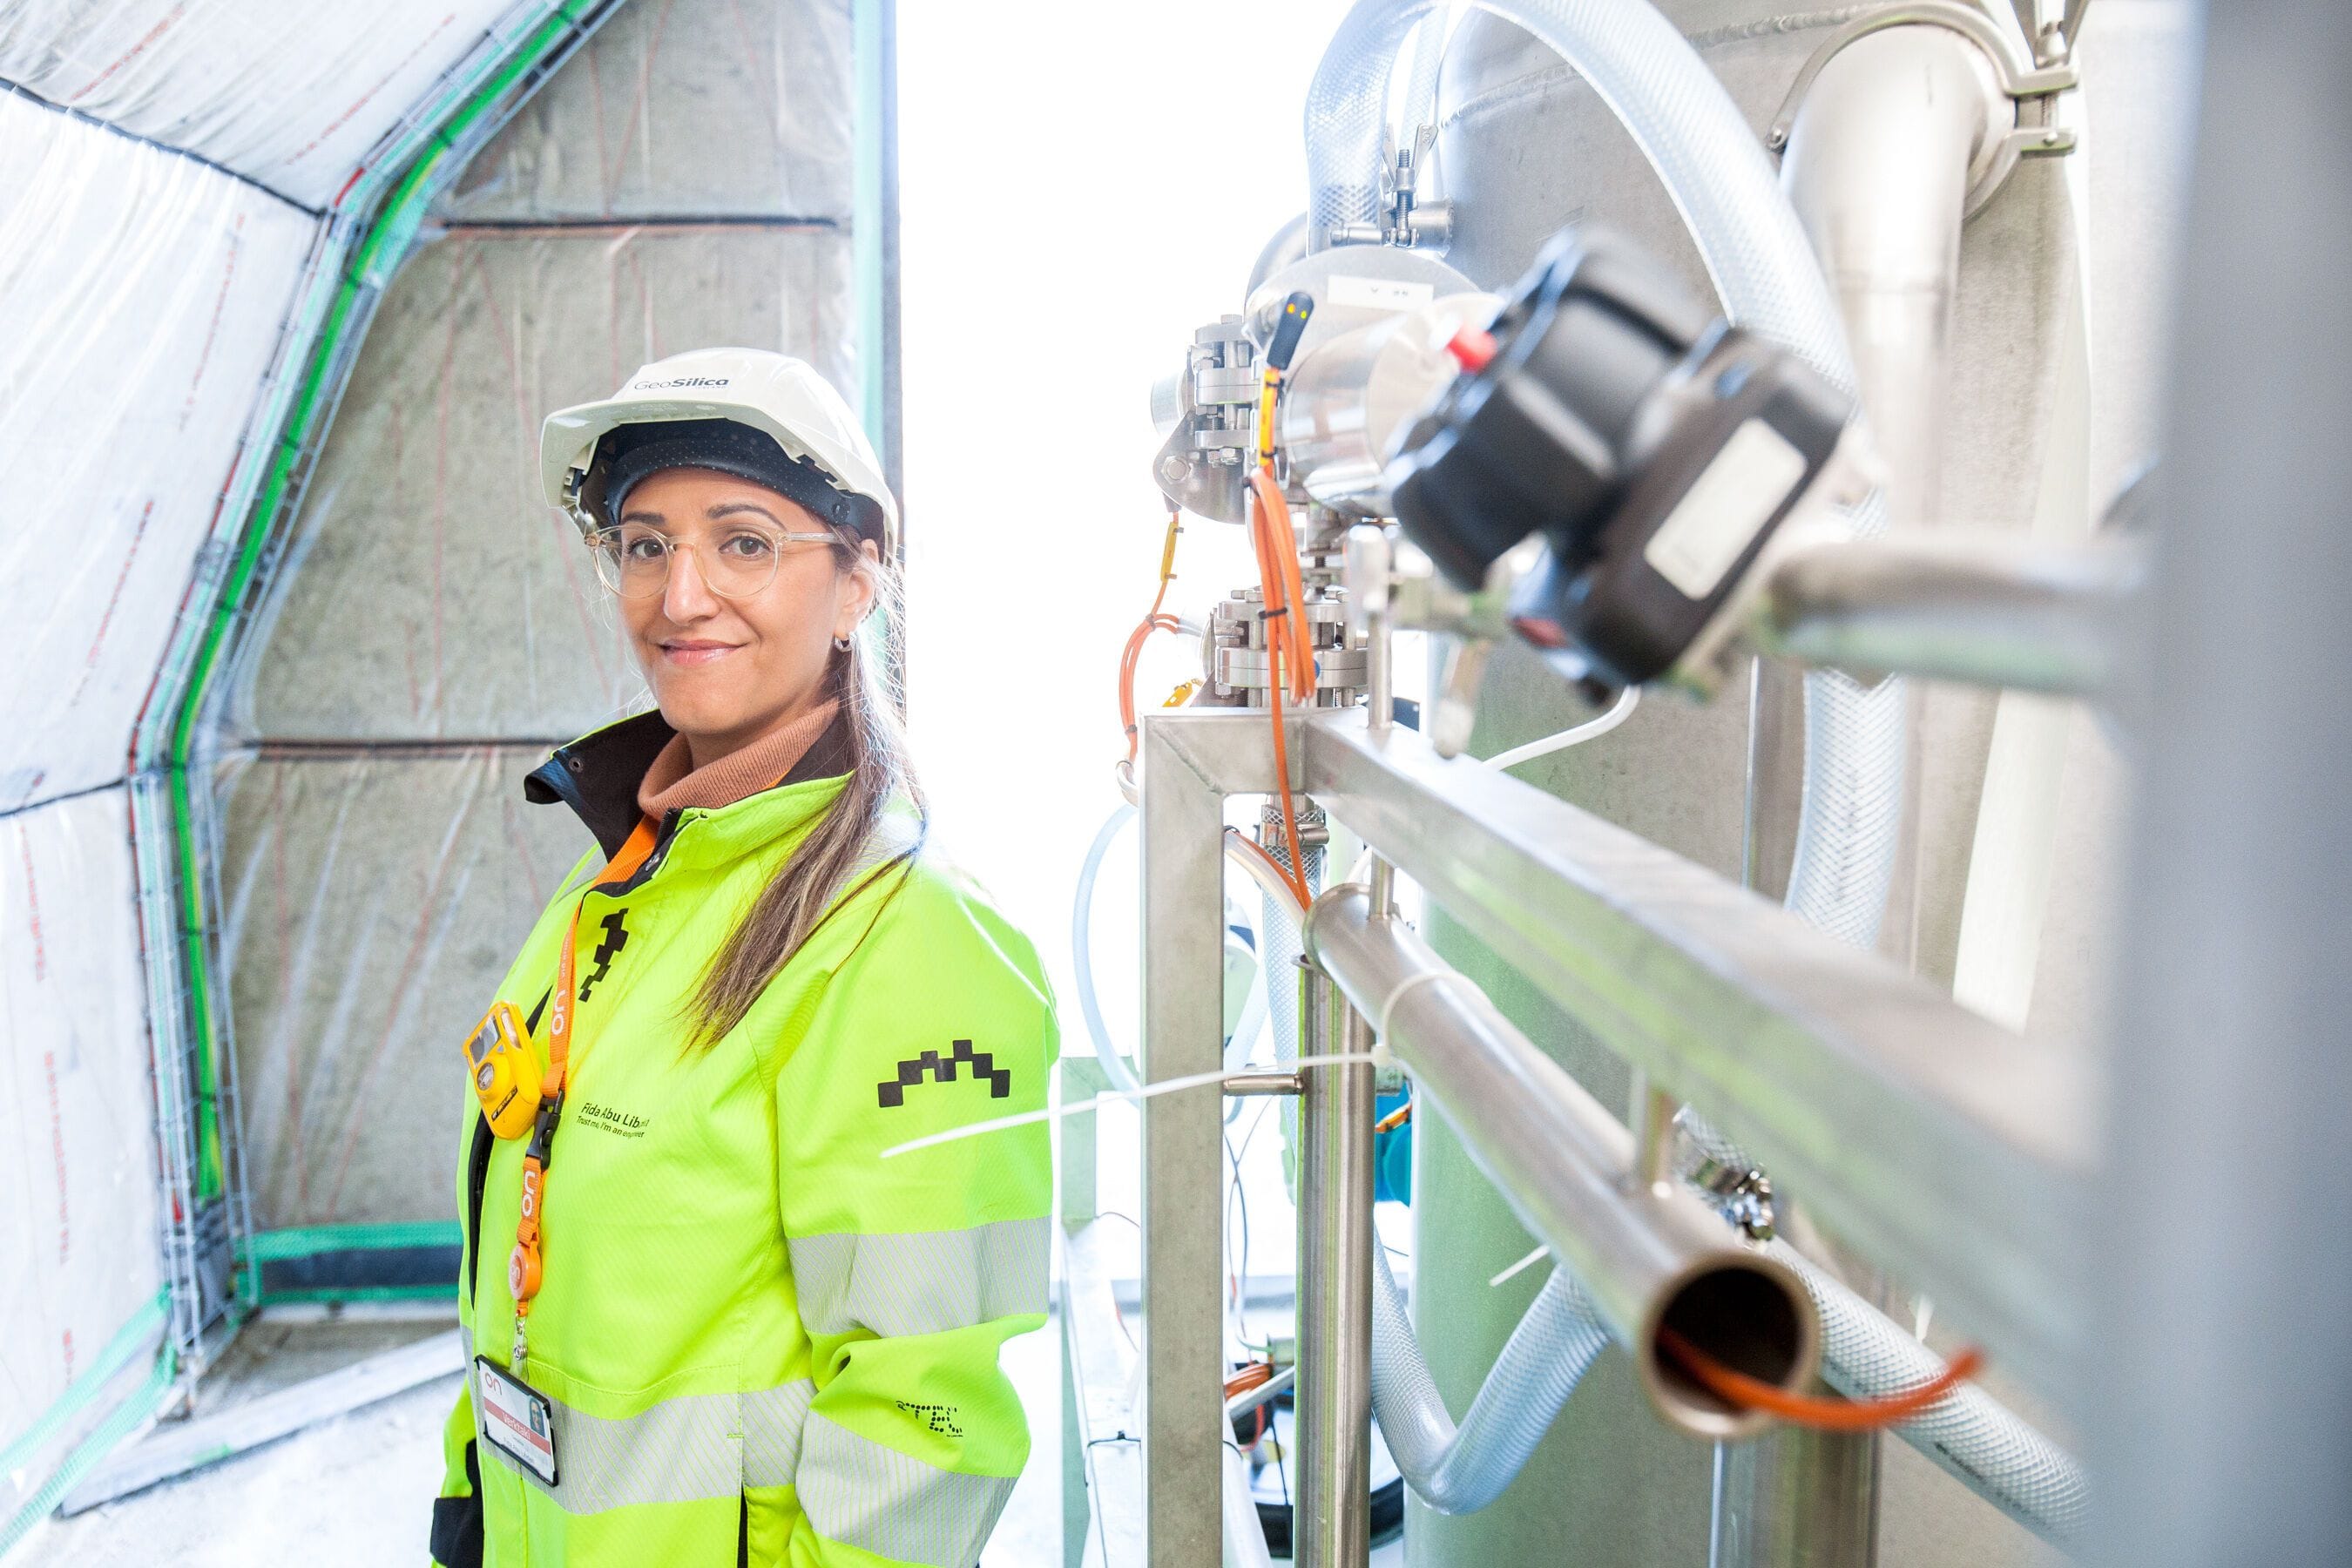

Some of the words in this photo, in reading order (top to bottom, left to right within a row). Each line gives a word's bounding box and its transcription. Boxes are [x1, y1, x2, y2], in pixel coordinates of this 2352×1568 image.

[634, 377, 730, 390] GeoSilica
[581, 1103, 600, 1117] Fida
[600, 1108, 621, 1122] Abu
[577, 1116, 591, 1125] Trust
[612, 1127, 623, 1136] an
